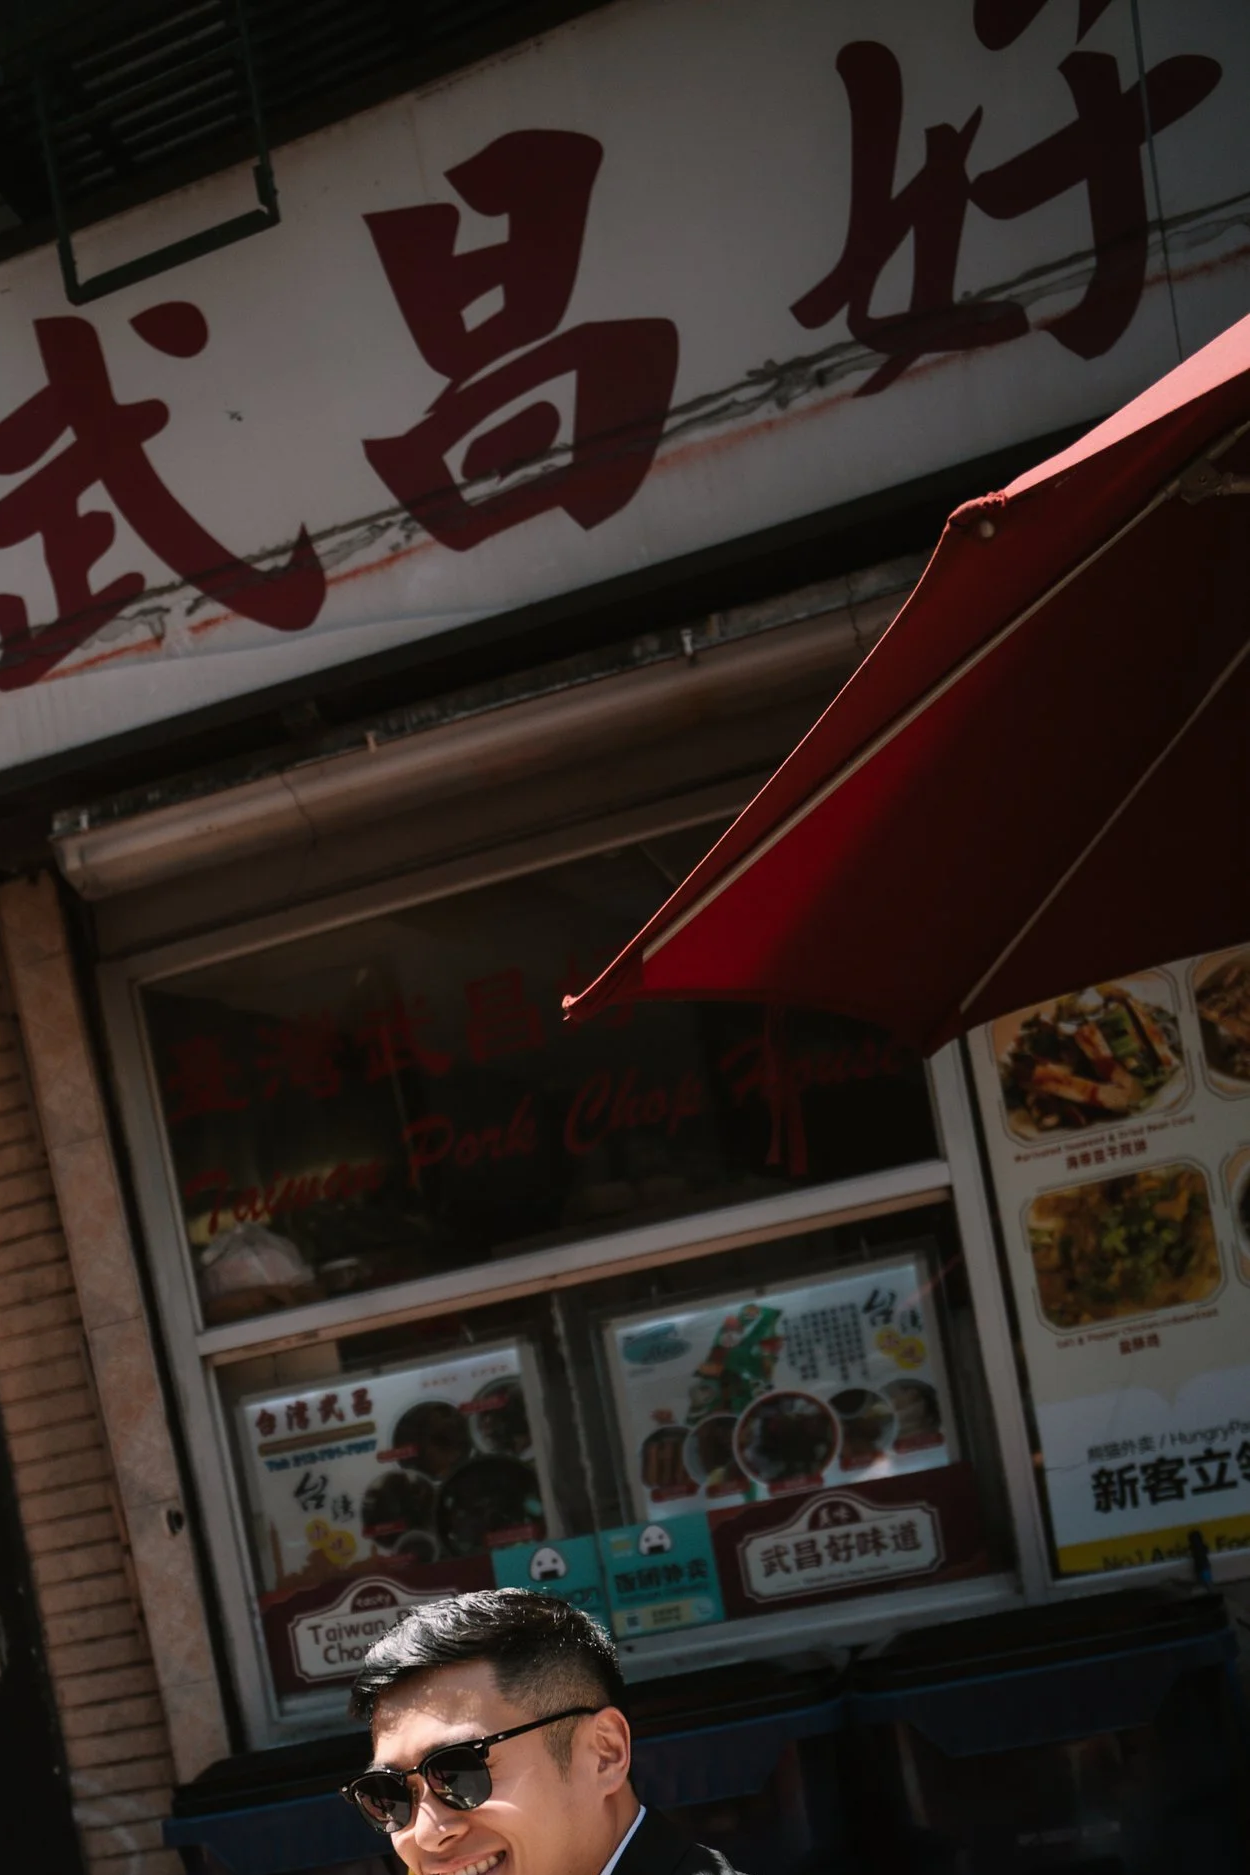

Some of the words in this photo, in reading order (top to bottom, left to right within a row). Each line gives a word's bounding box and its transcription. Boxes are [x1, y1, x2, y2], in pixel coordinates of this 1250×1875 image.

[186, 1154, 387, 1234] Taiwan
[401, 1092, 539, 1192] Pork
[562, 1067, 707, 1157] Chop
[759, 1517, 922, 1579] 武昌好味道
[306, 1619, 387, 1646] Taiwan
